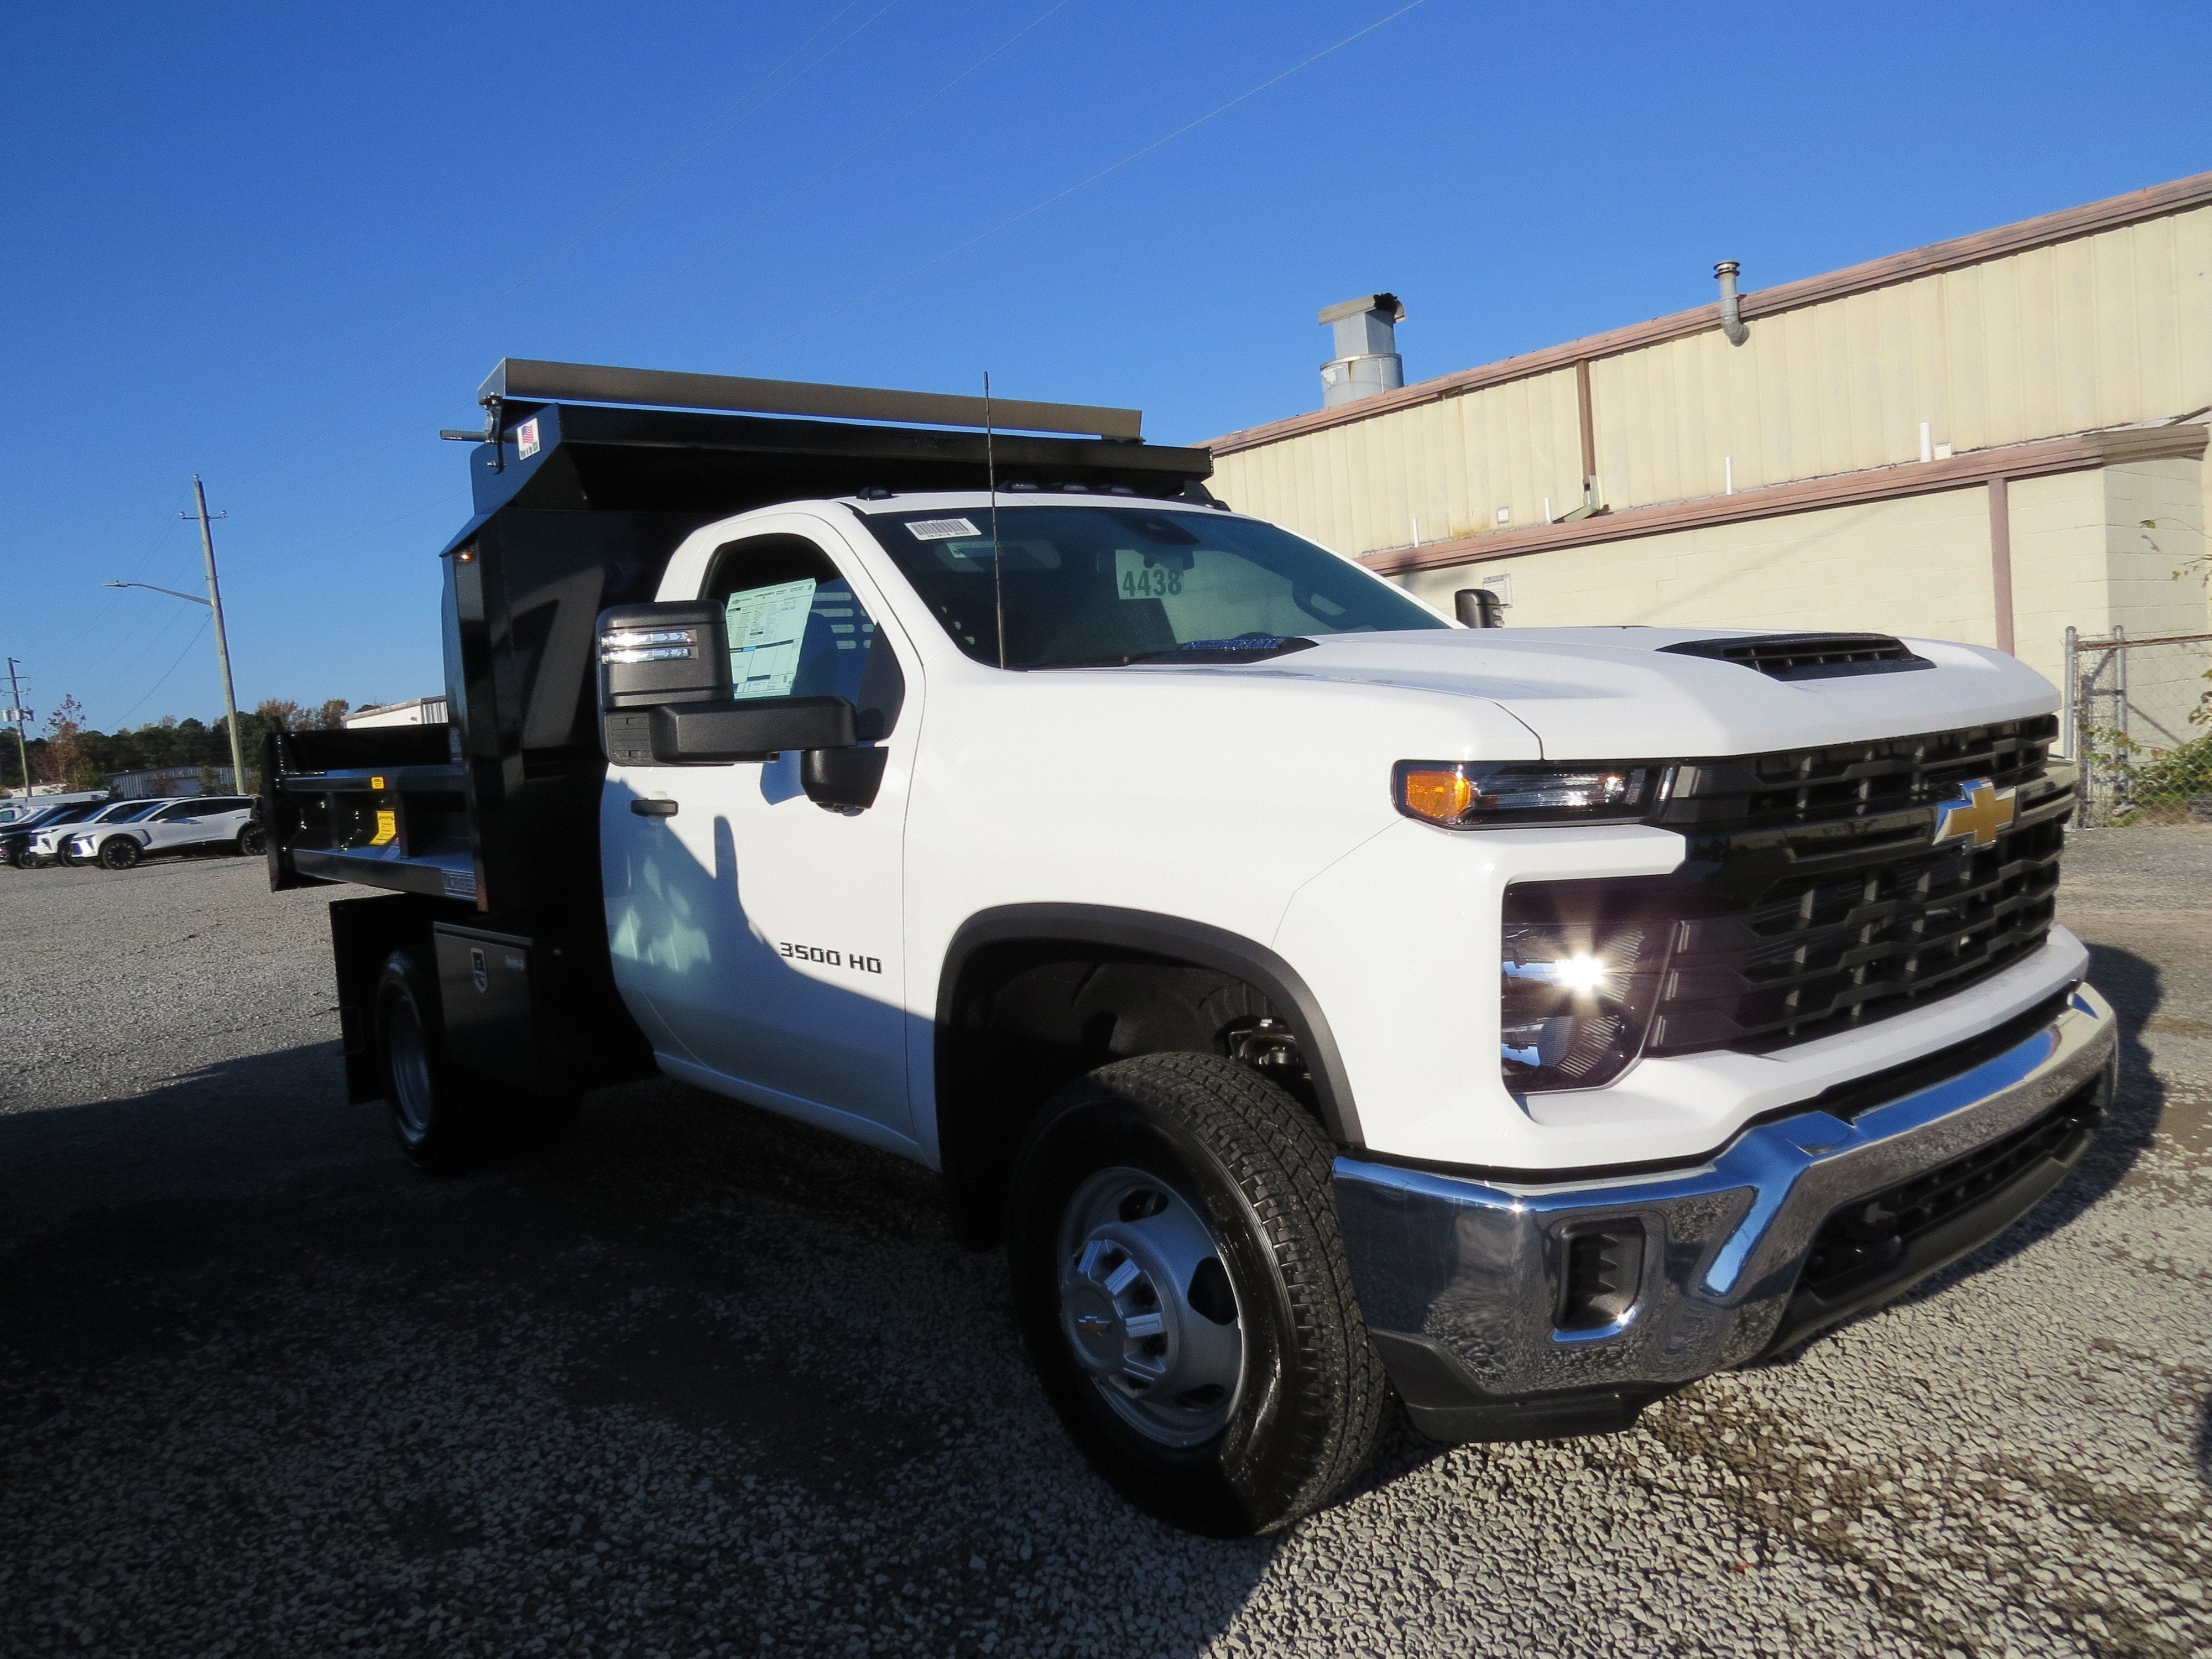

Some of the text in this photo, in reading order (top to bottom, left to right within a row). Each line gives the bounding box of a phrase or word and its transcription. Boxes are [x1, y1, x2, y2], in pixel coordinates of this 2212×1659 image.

[1122, 570, 1182, 596] 4438
[780, 942, 882, 974] 3500 HD
